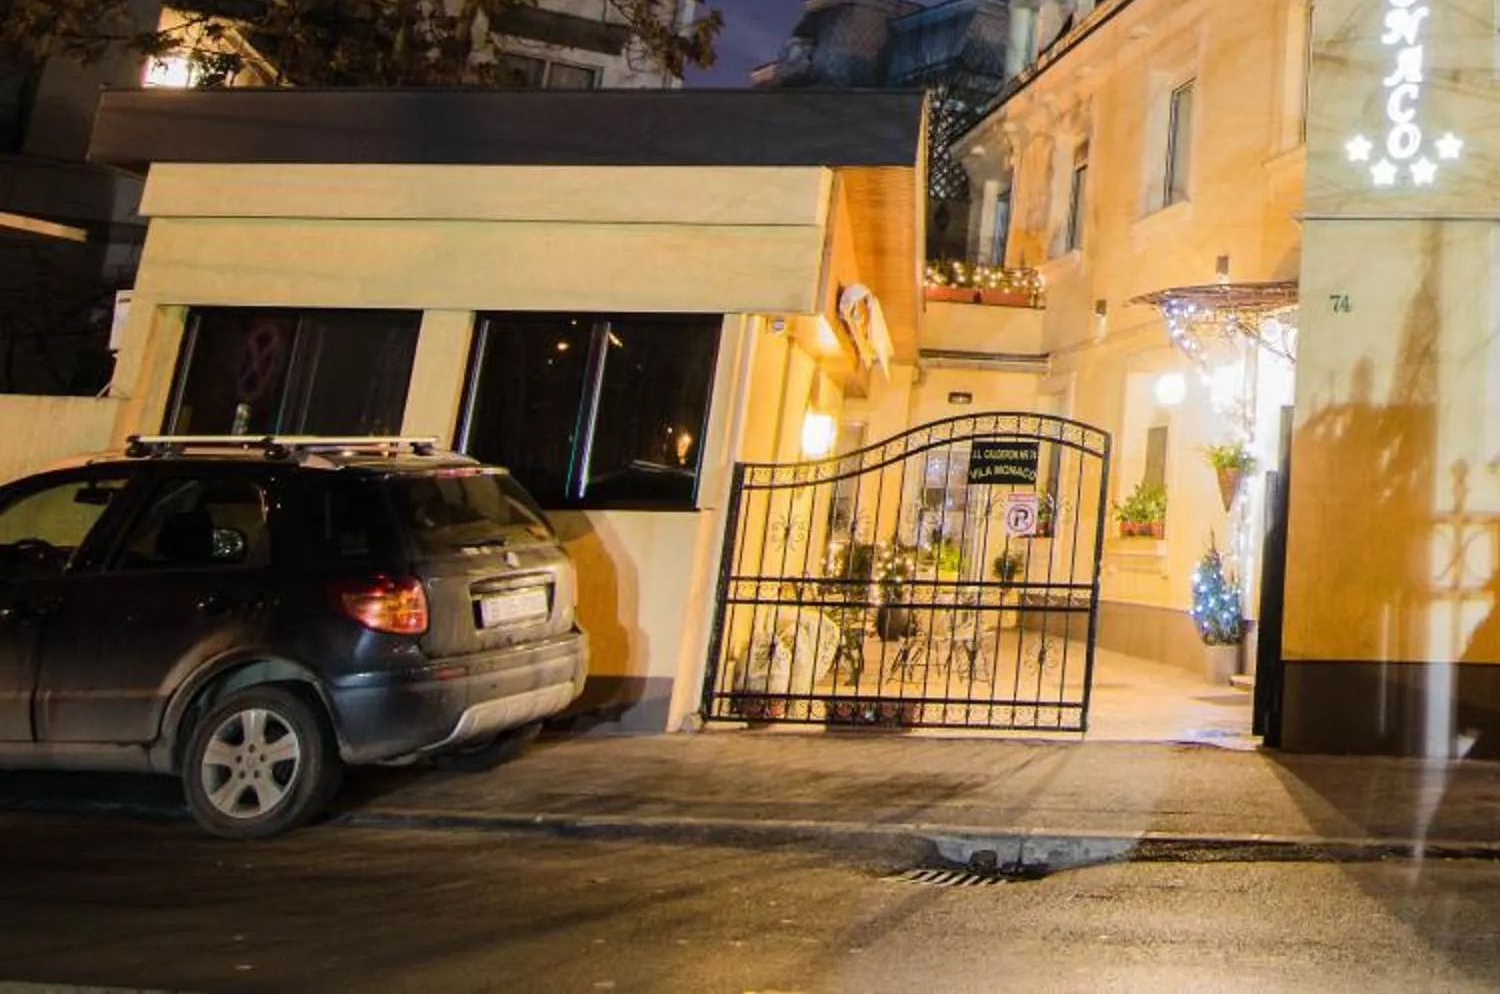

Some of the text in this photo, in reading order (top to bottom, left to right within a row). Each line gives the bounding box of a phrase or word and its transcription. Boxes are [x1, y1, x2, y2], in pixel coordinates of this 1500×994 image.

[1329, 294, 1352, 314] 74
[970, 465, 1038, 481] VILA MONACO
